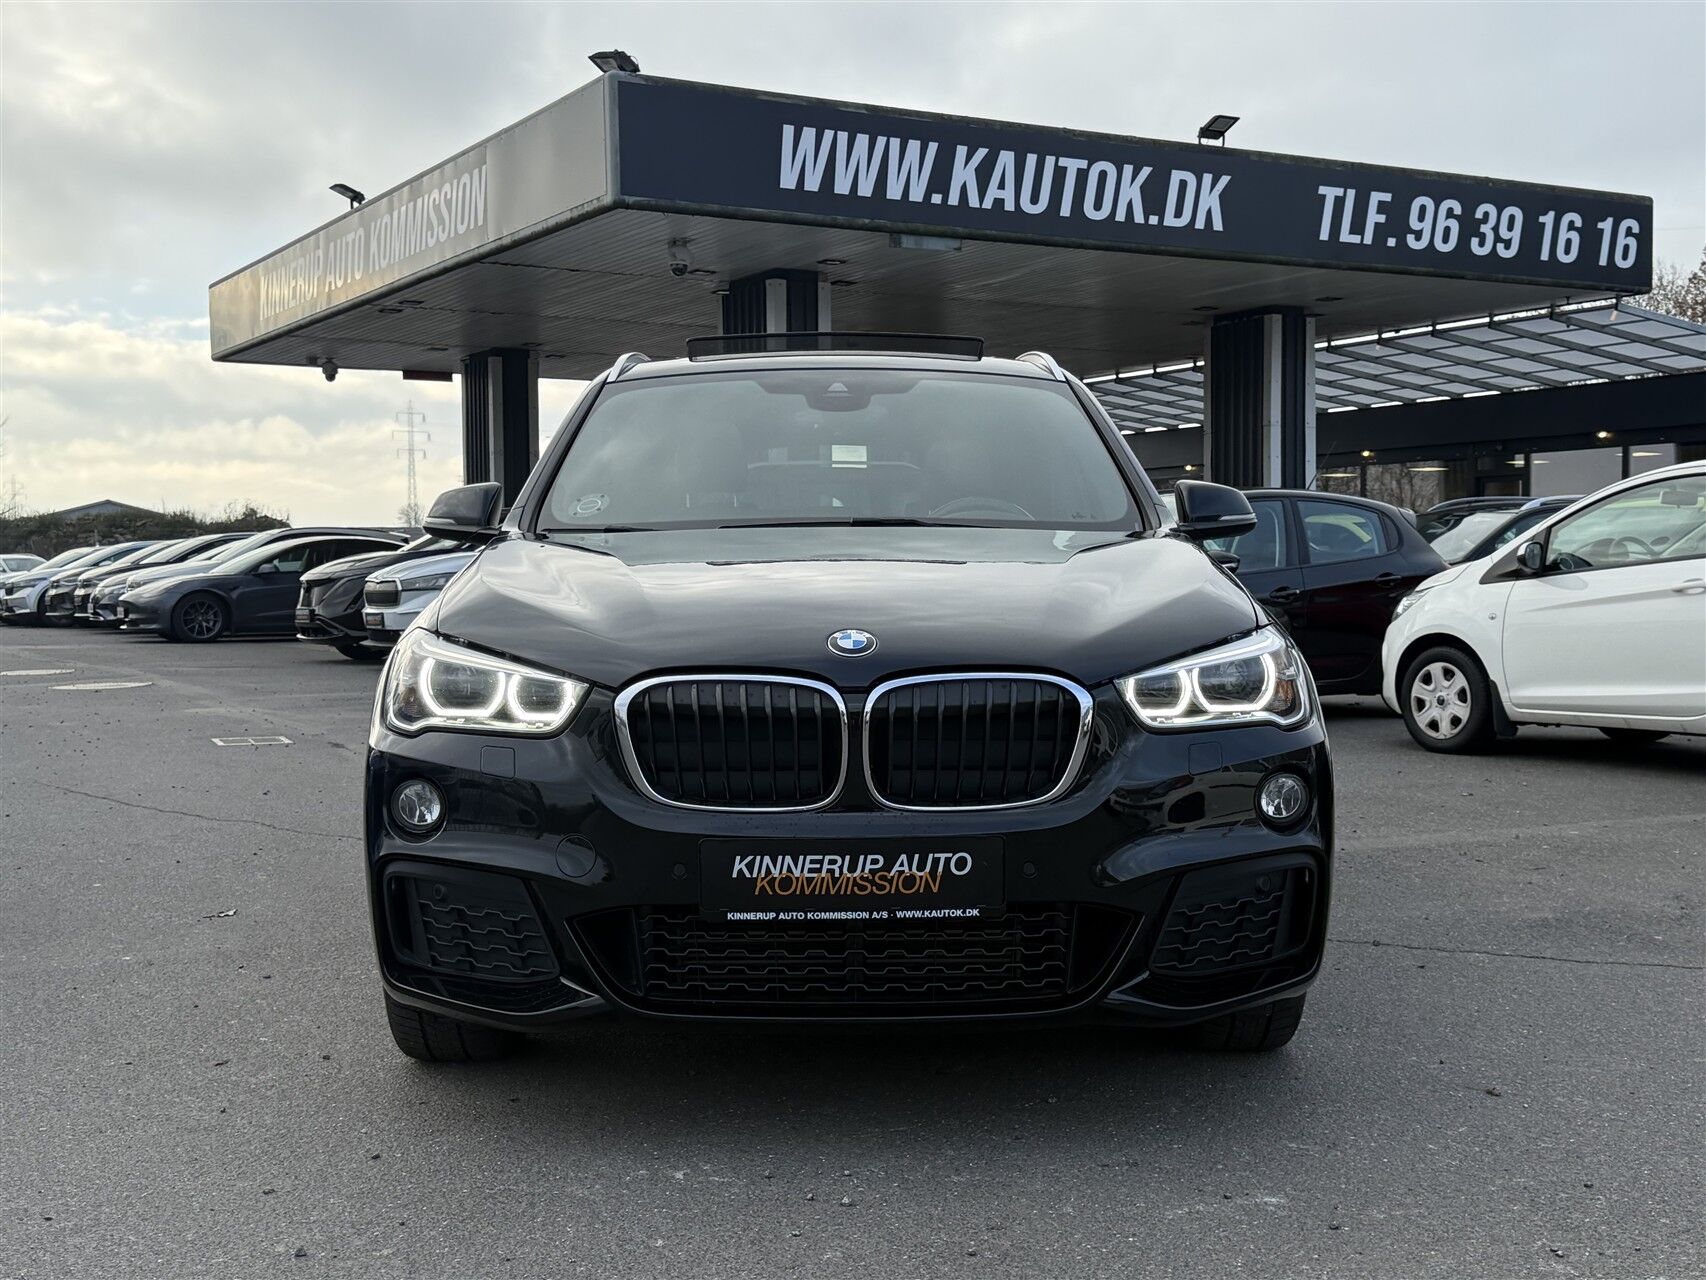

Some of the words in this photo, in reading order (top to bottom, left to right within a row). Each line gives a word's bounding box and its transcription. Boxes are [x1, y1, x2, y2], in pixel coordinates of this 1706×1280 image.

[779, 123, 1232, 232] WWW.KAUTOK.DK
[260, 243, 325, 321] KINNERUP
[325, 227, 365, 292] AUTO
[369, 165, 488, 274] KOMMISSION
[1317, 185, 1397, 247] TLF.
[1406, 195, 1463, 253] 96
[1470, 203, 1524, 259] 39
[1538, 210, 1583, 264] 16
[1597, 217, 1640, 270] 16
[731, 854, 884, 878] KINNERUP
[889, 852, 973, 876] AUTO
[754, 871, 943, 896] KOMMISSION
[727, 912, 777, 920] KINNERUP
[778, 912, 805, 920] AUTO
[807, 911, 870, 920] KOMMISSION
[871, 911, 889, 919] A/S
[895, 908, 980, 918] WWW.KAUTOK.DK
